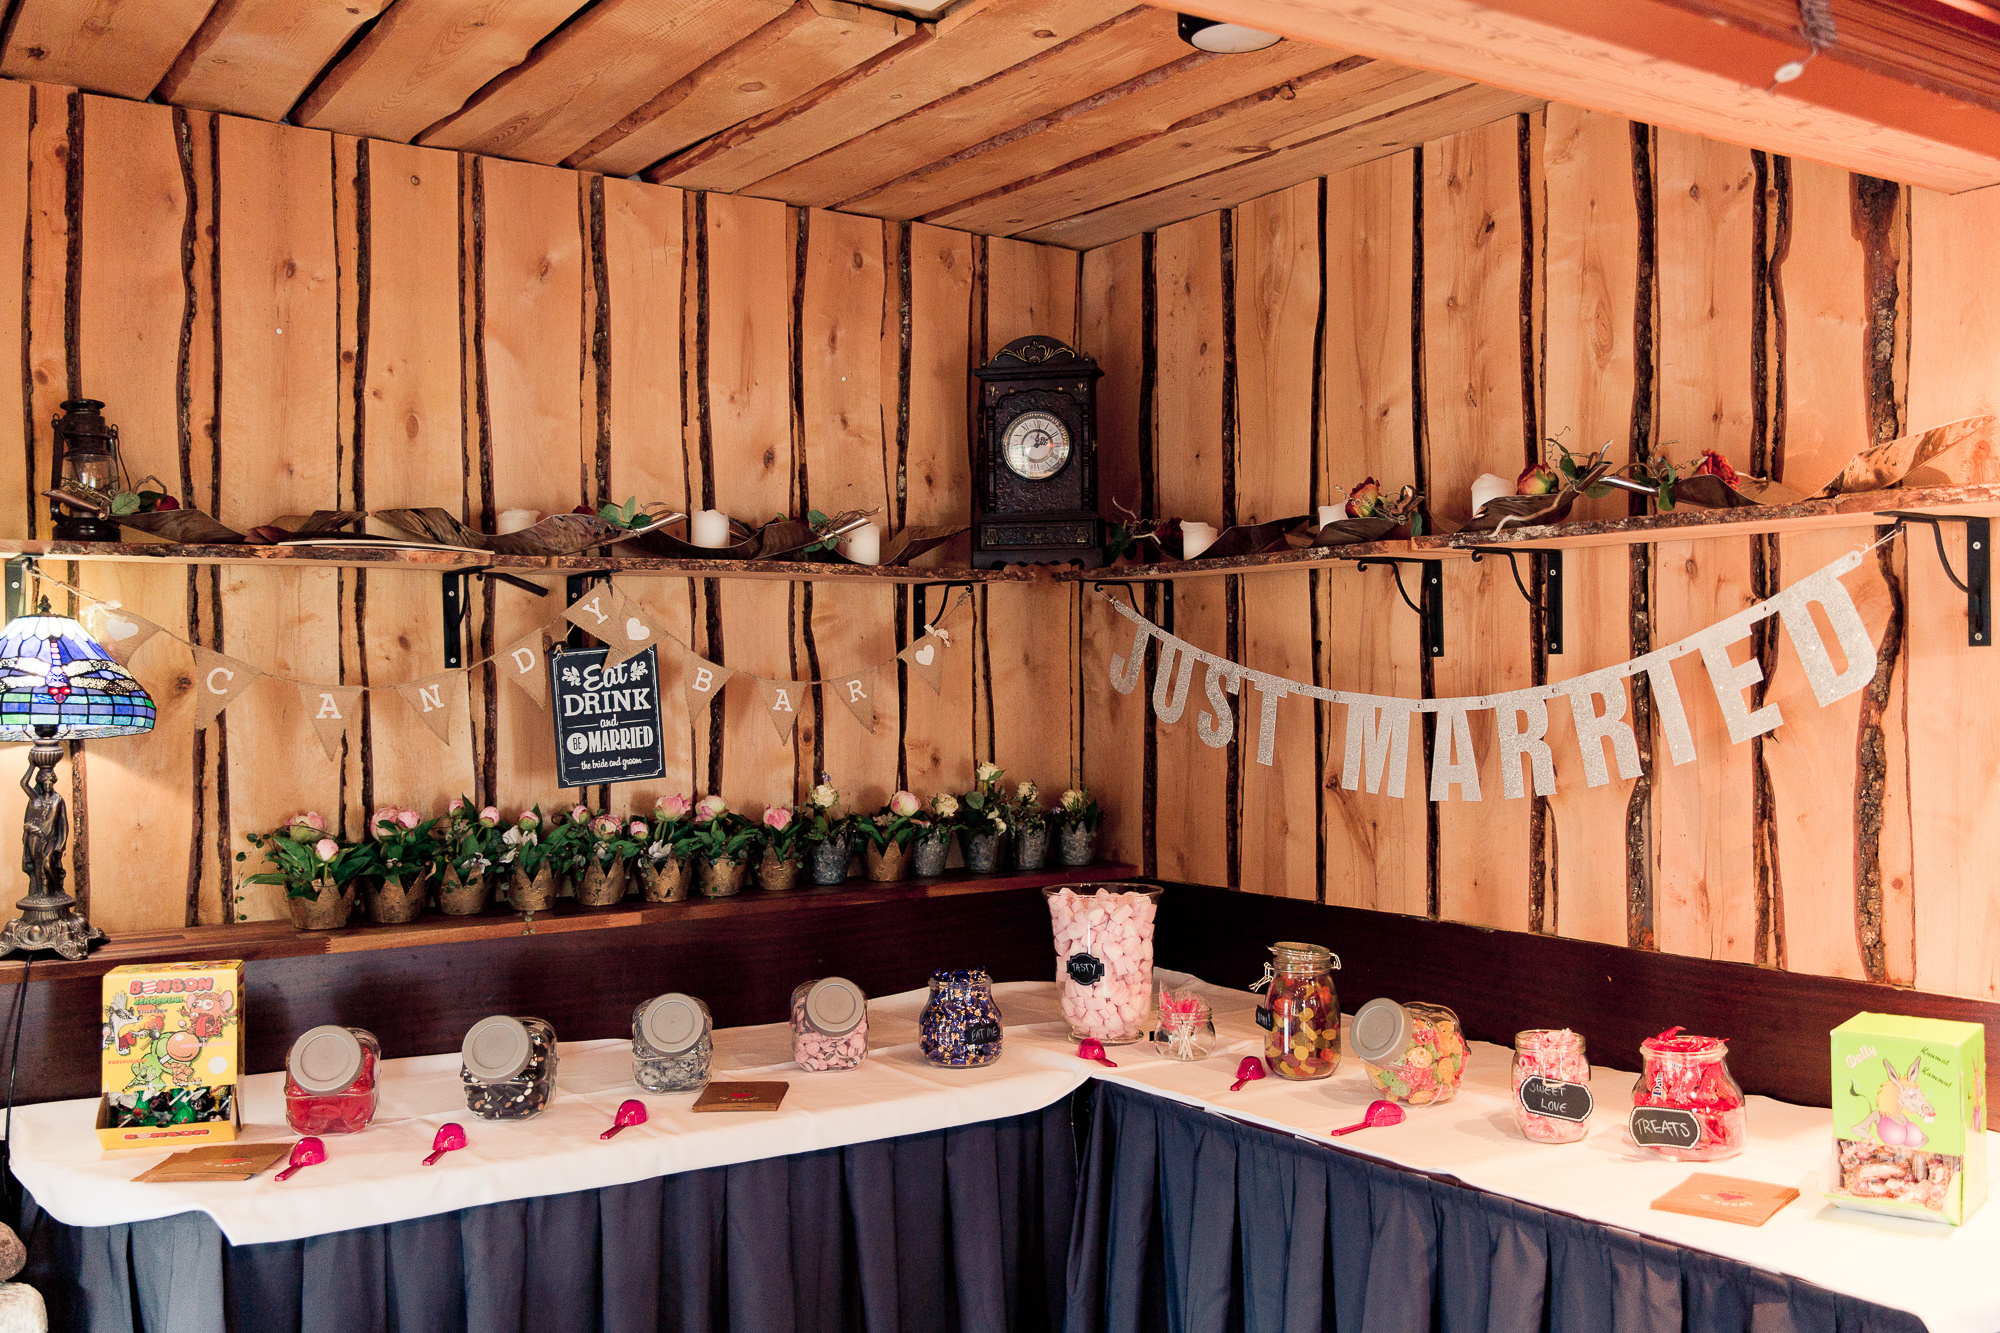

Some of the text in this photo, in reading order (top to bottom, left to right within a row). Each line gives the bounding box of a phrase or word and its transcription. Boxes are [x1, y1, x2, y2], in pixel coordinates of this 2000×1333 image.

[582, 662, 628, 692] Eat
[1109, 575, 1878, 802] JUST MARRIED
[563, 687, 652, 717] DRINK
[600, 714, 619, 728] and
[572, 725, 654, 754] BE MARRIED
[581, 756, 643, 771] the bride and groom
[1071, 962, 1096, 976] TASTY
[129, 977, 214, 996] BONBON
[971, 1026, 998, 1042] EAT ME
[1528, 1082, 1567, 1097] SWEET
[1541, 1098, 1568, 1113] LOVE
[1634, 1117, 1691, 1138] TREATS
